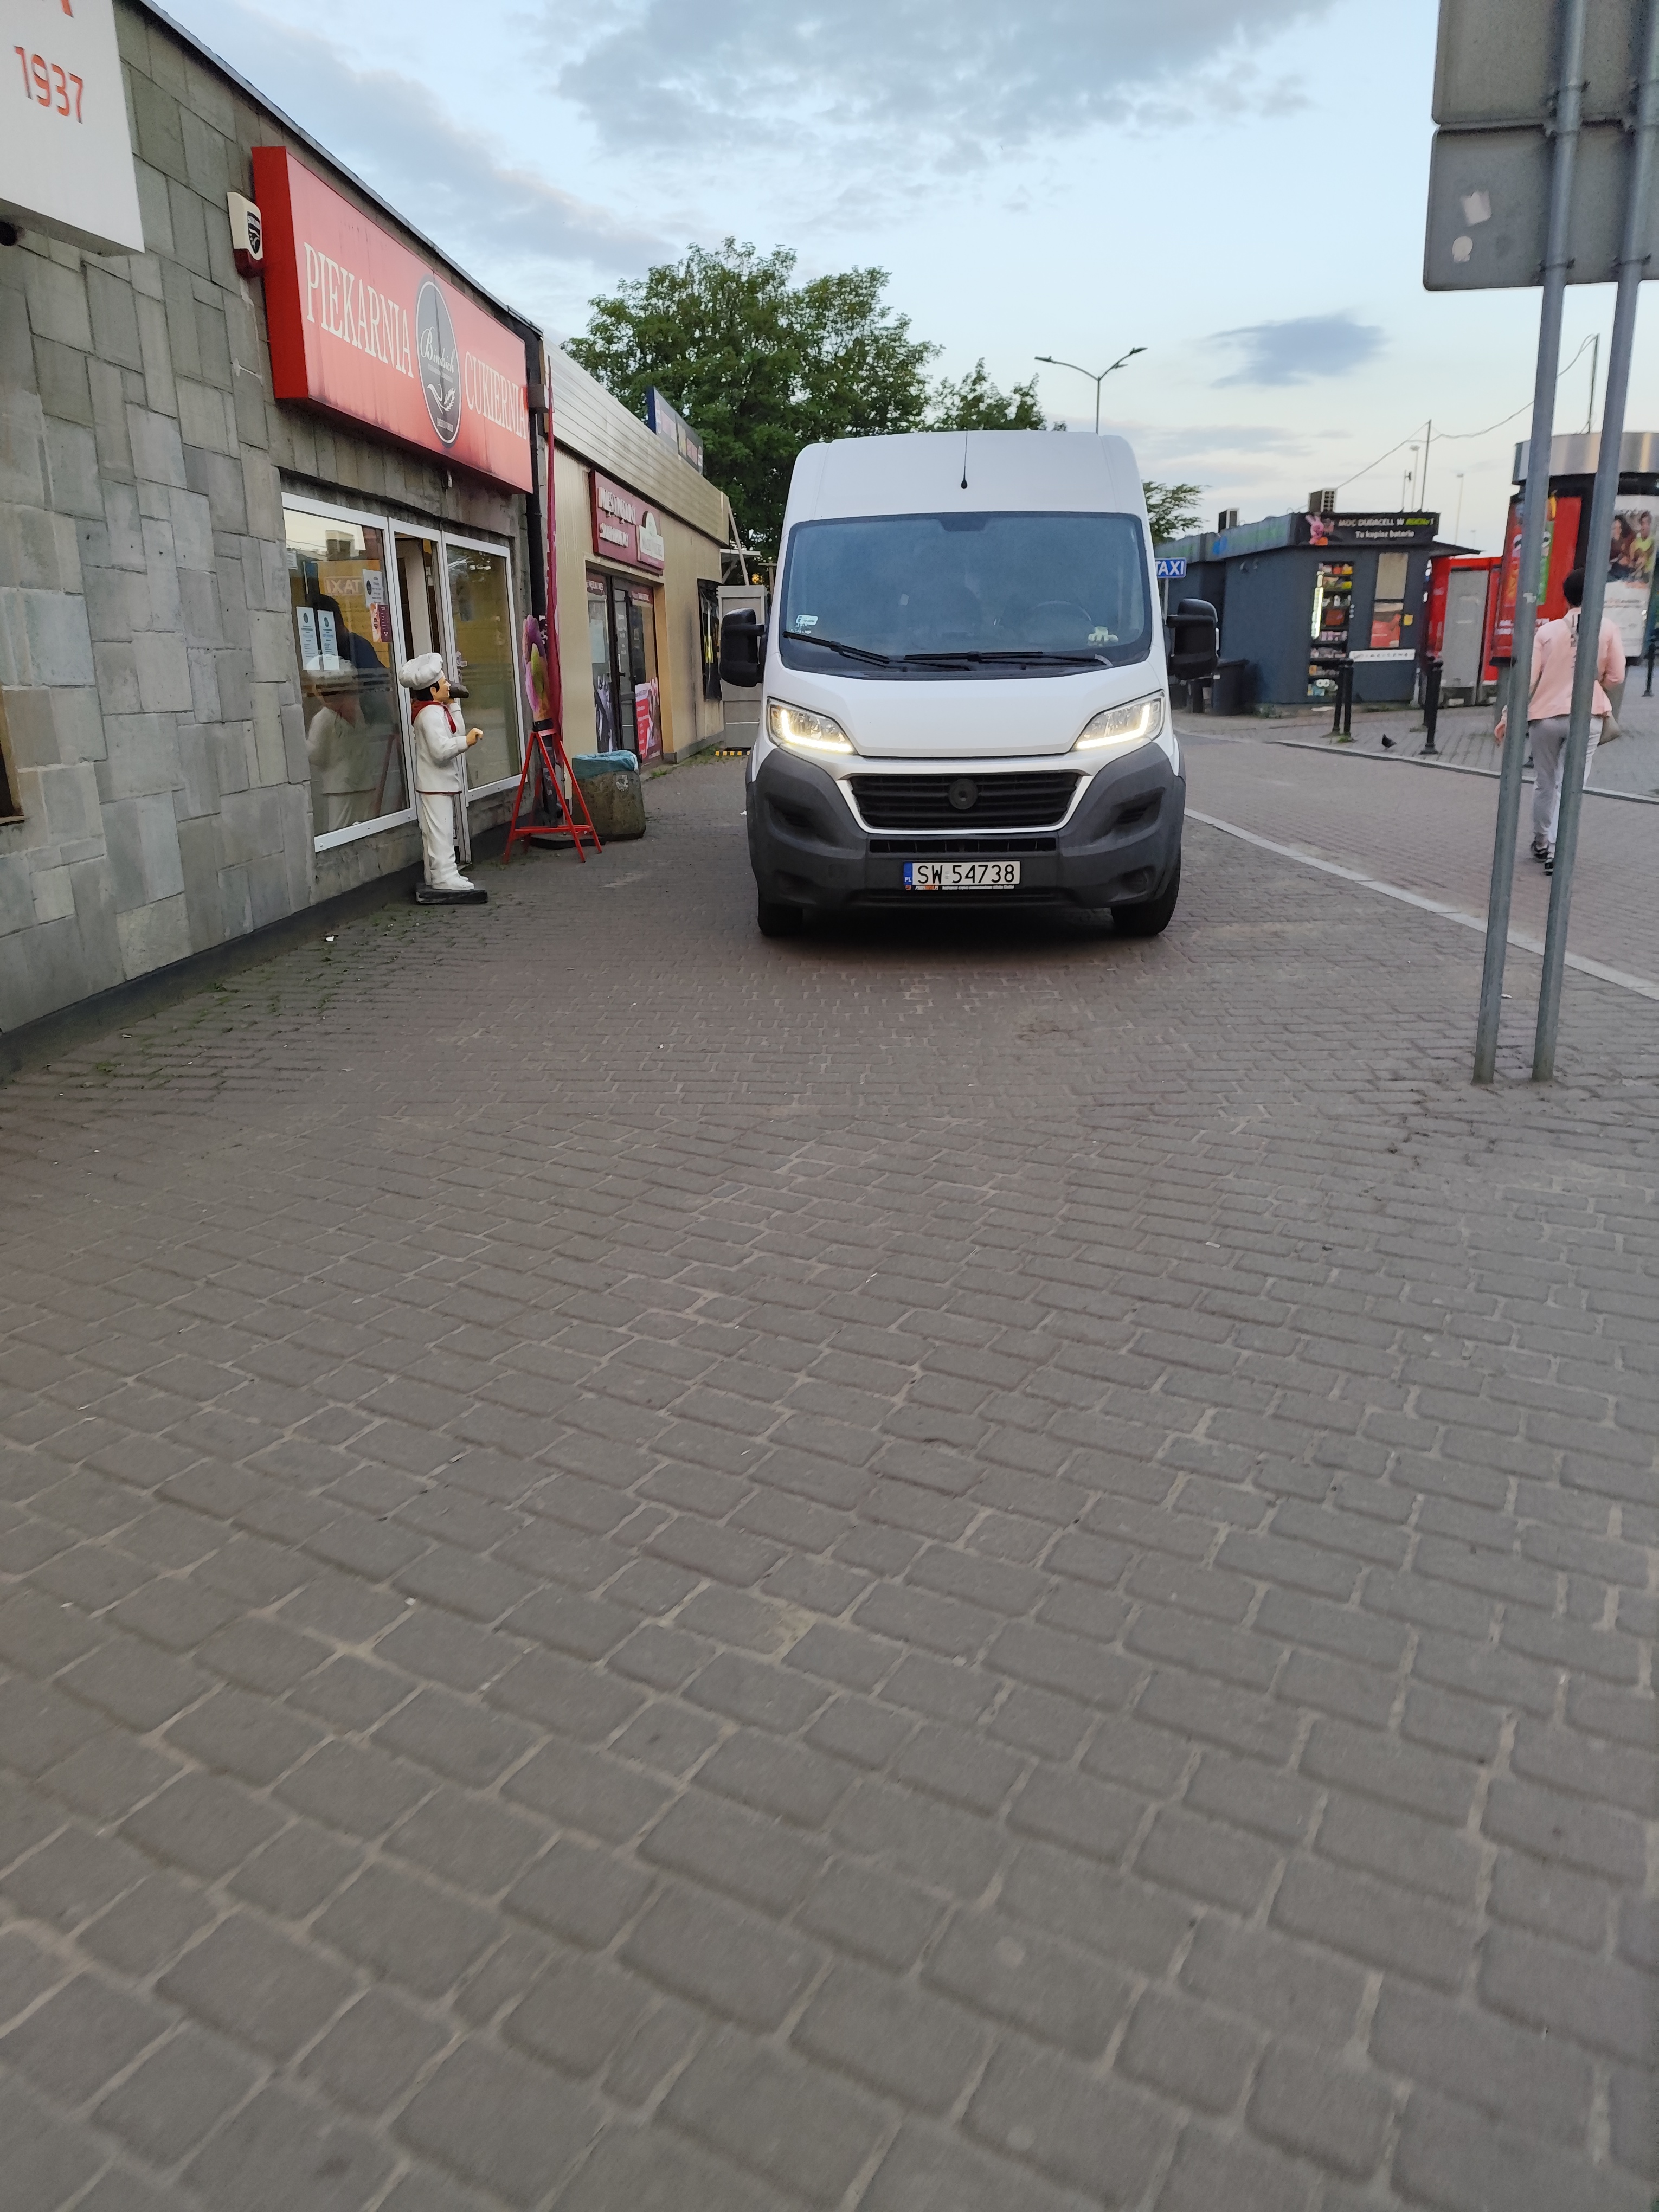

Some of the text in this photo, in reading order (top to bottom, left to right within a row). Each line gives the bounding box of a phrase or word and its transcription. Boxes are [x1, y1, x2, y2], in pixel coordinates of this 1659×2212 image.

[14, 46, 83, 124] 1937
[304, 242, 414, 378] PIEKARNIA
[420, 326, 454, 374] Bindrich
[465, 351, 527, 440] CUKIERNIA
[1155, 561, 1184, 575] TAXI
[918, 864, 1014, 884] SW 54738
